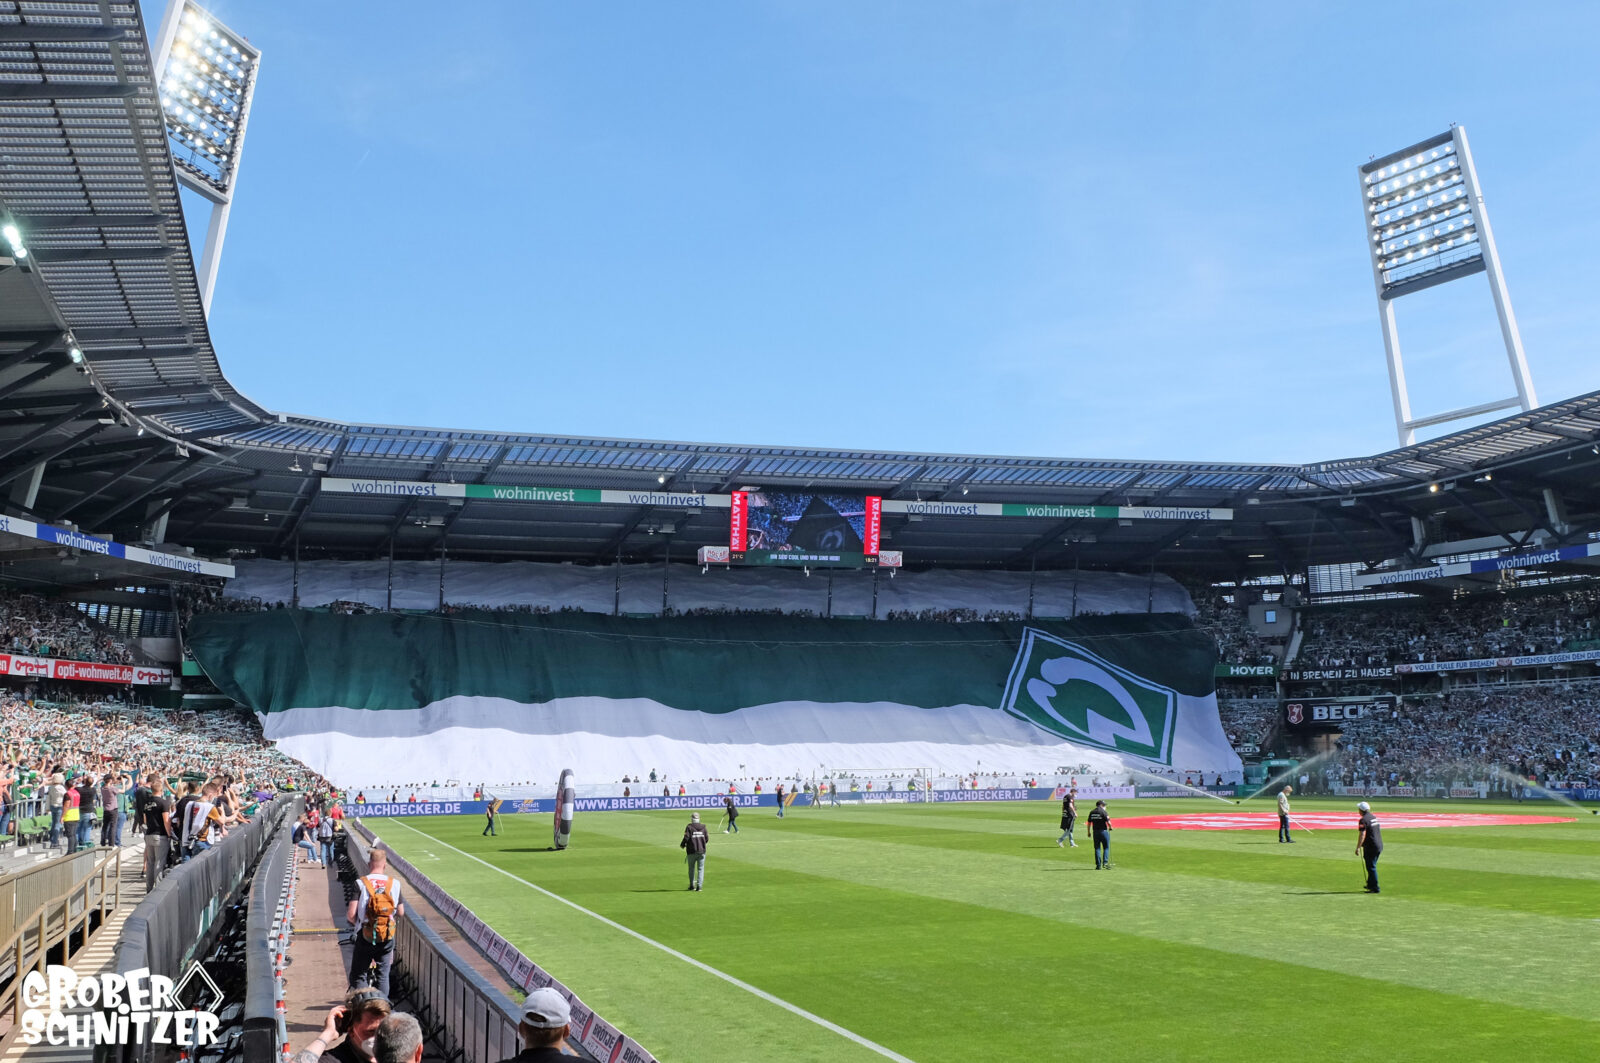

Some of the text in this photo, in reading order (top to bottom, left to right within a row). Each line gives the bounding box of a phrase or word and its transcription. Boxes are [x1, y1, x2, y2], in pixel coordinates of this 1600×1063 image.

[351, 480, 437, 497] wohninvest
[493, 486, 575, 502] wohninvest
[628, 493, 706, 507] wohninvest
[905, 500, 978, 516] wohninvest
[1025, 504, 1096, 518] wohninvest
[1143, 507, 1211, 520] wohninvest
[55, 531, 109, 555] wohninvest
[149, 552, 202, 574] wohninvest
[1496, 550, 1561, 570] wohninvest
[1379, 567, 1445, 585] wohninvest
[1469, 660, 1495, 668] BREMEN
[1514, 656, 1547, 664] OFFENSIV
[1548, 654, 1571, 662] GEGEN
[1572, 652, 1586, 660] DEN
[58, 665, 132, 681] opti-wohnwelt.de
[1230, 666, 1273, 675] HOYER
[1290, 672, 1300, 680] IN
[1302, 669, 1342, 680] BREMEN
[1345, 669, 1358, 678] ZU
[1360, 668, 1392, 677] HAUSE
[344, 803, 461, 817] R-DACHDECKER.DE
[592, 1023, 616, 1049] BRÖTJE
